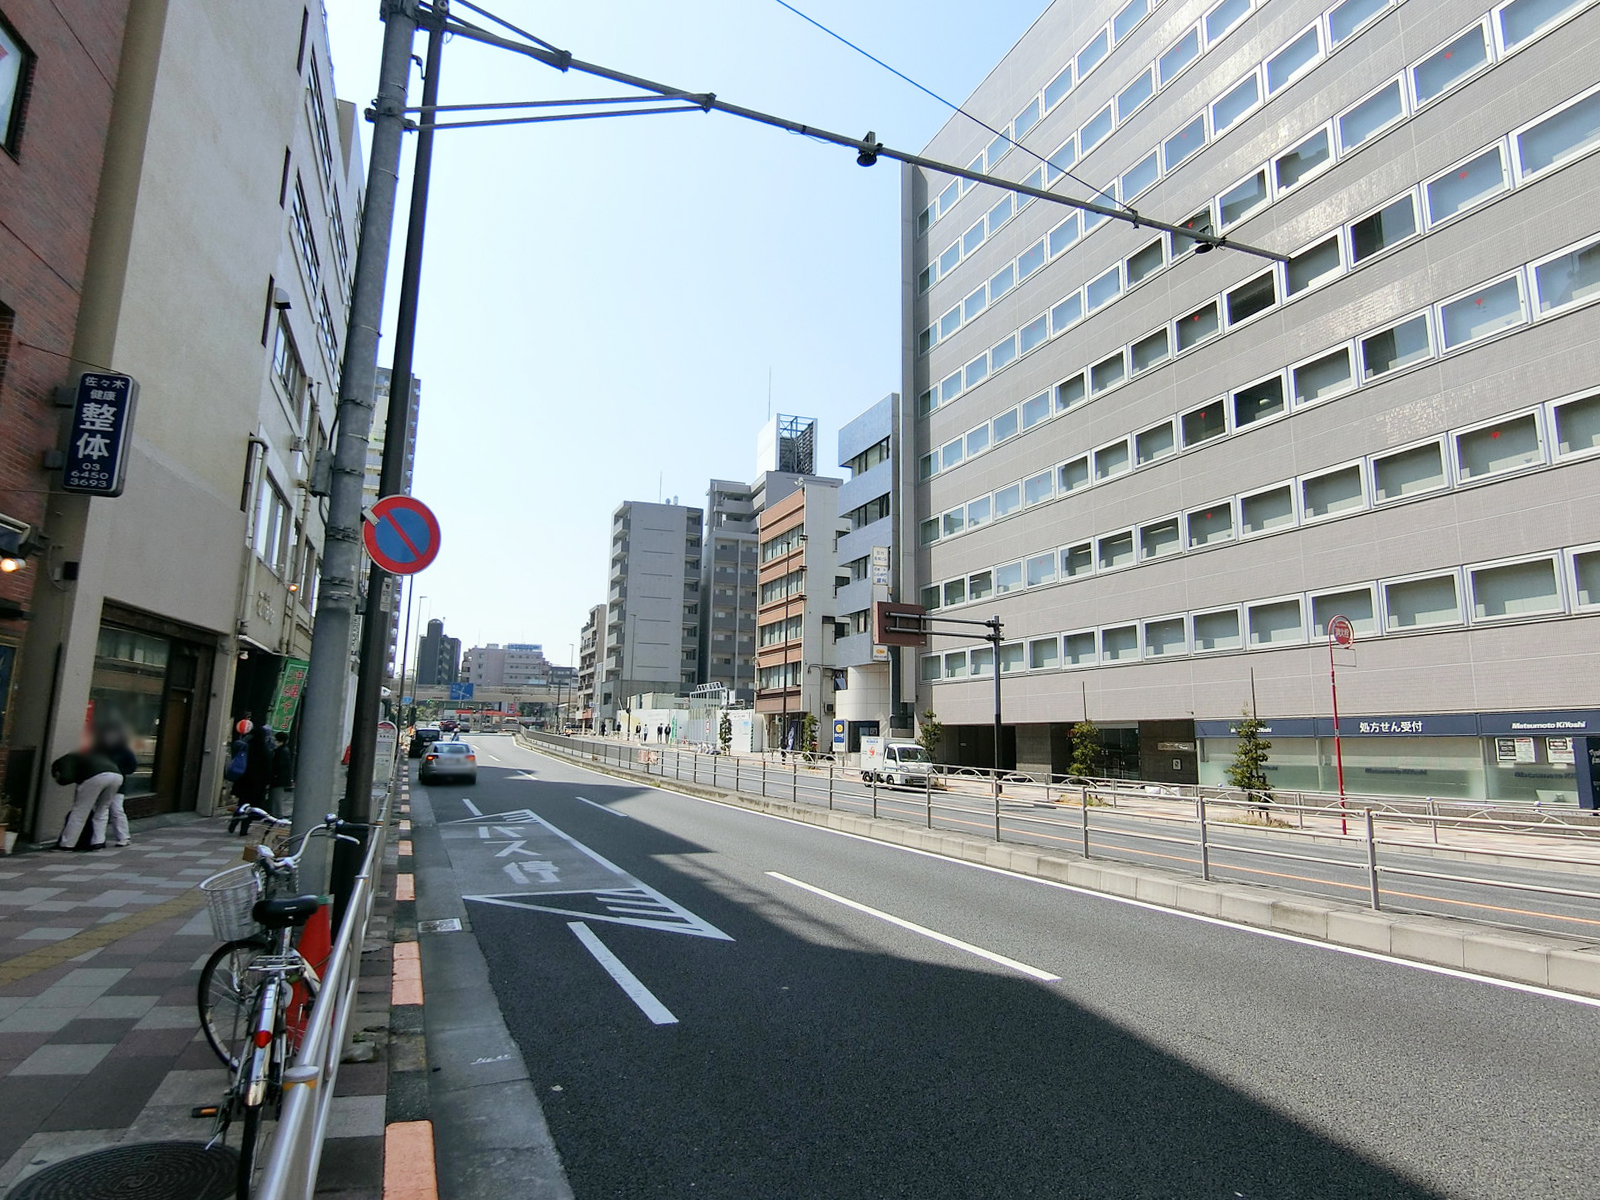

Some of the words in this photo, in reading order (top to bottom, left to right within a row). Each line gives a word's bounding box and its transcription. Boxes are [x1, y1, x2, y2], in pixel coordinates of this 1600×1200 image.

[85, 376, 126, 389] 佐々木
[90, 389, 117, 401] 健康
[76, 402, 117, 460] 整体
[82, 462, 101, 471] 03
[71, 470, 109, 480] 6450
[69, 478, 108, 487] 3693
[1359, 720, 1423, 733] 処方せん受付
